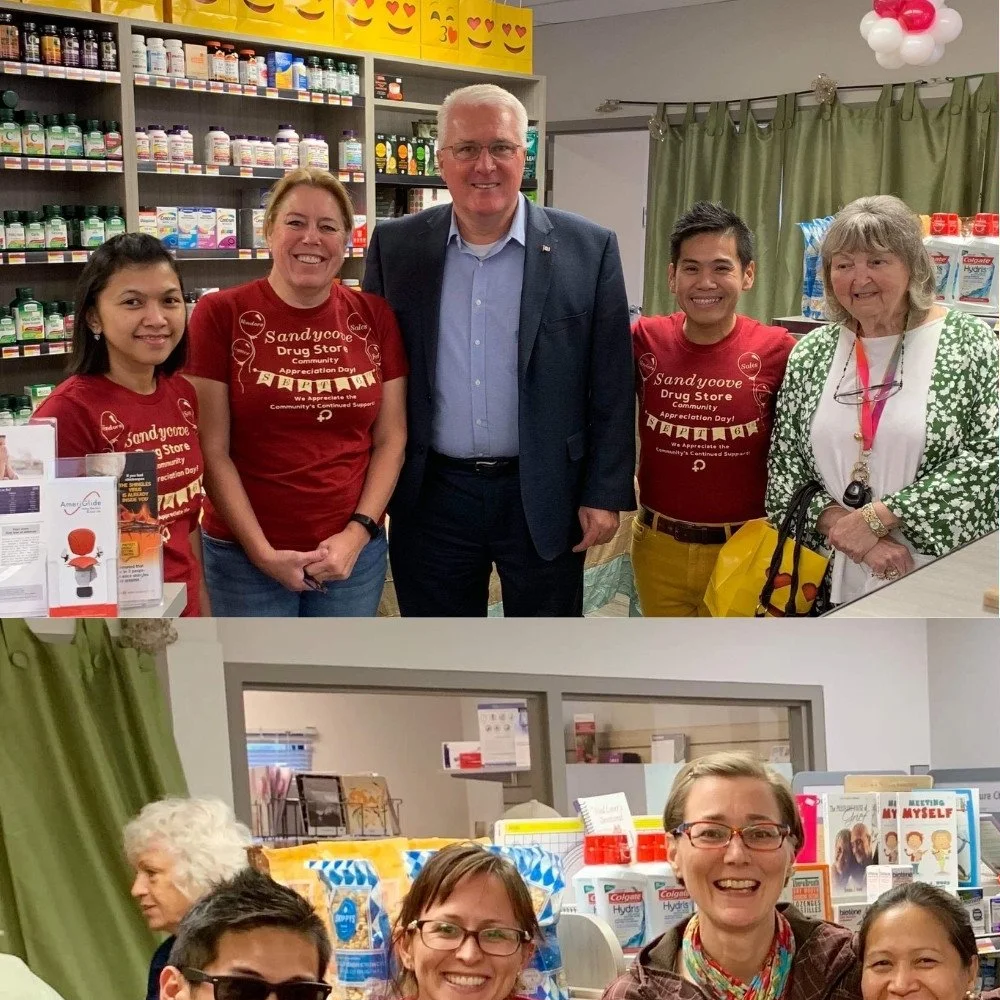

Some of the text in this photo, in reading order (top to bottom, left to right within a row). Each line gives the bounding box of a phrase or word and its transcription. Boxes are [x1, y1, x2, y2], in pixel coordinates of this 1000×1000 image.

[264, 328, 353, 344] Sandycove
[276, 344, 348, 358] Drug Store
[279, 366, 356, 375] Appreciation Day!
[654, 372, 743, 389] Sandycove
[661, 389, 733, 402] Drug Store
[672, 402, 718, 412] Community
[660, 412, 735, 424] Appreciation Day!
[164, 442, 190, 458] Store
[902, 808, 953, 819] MYSELF
[610, 892, 642, 902] Colgate
[613, 905, 640, 914] Hydris
[663, 901, 688, 910] Hydris
